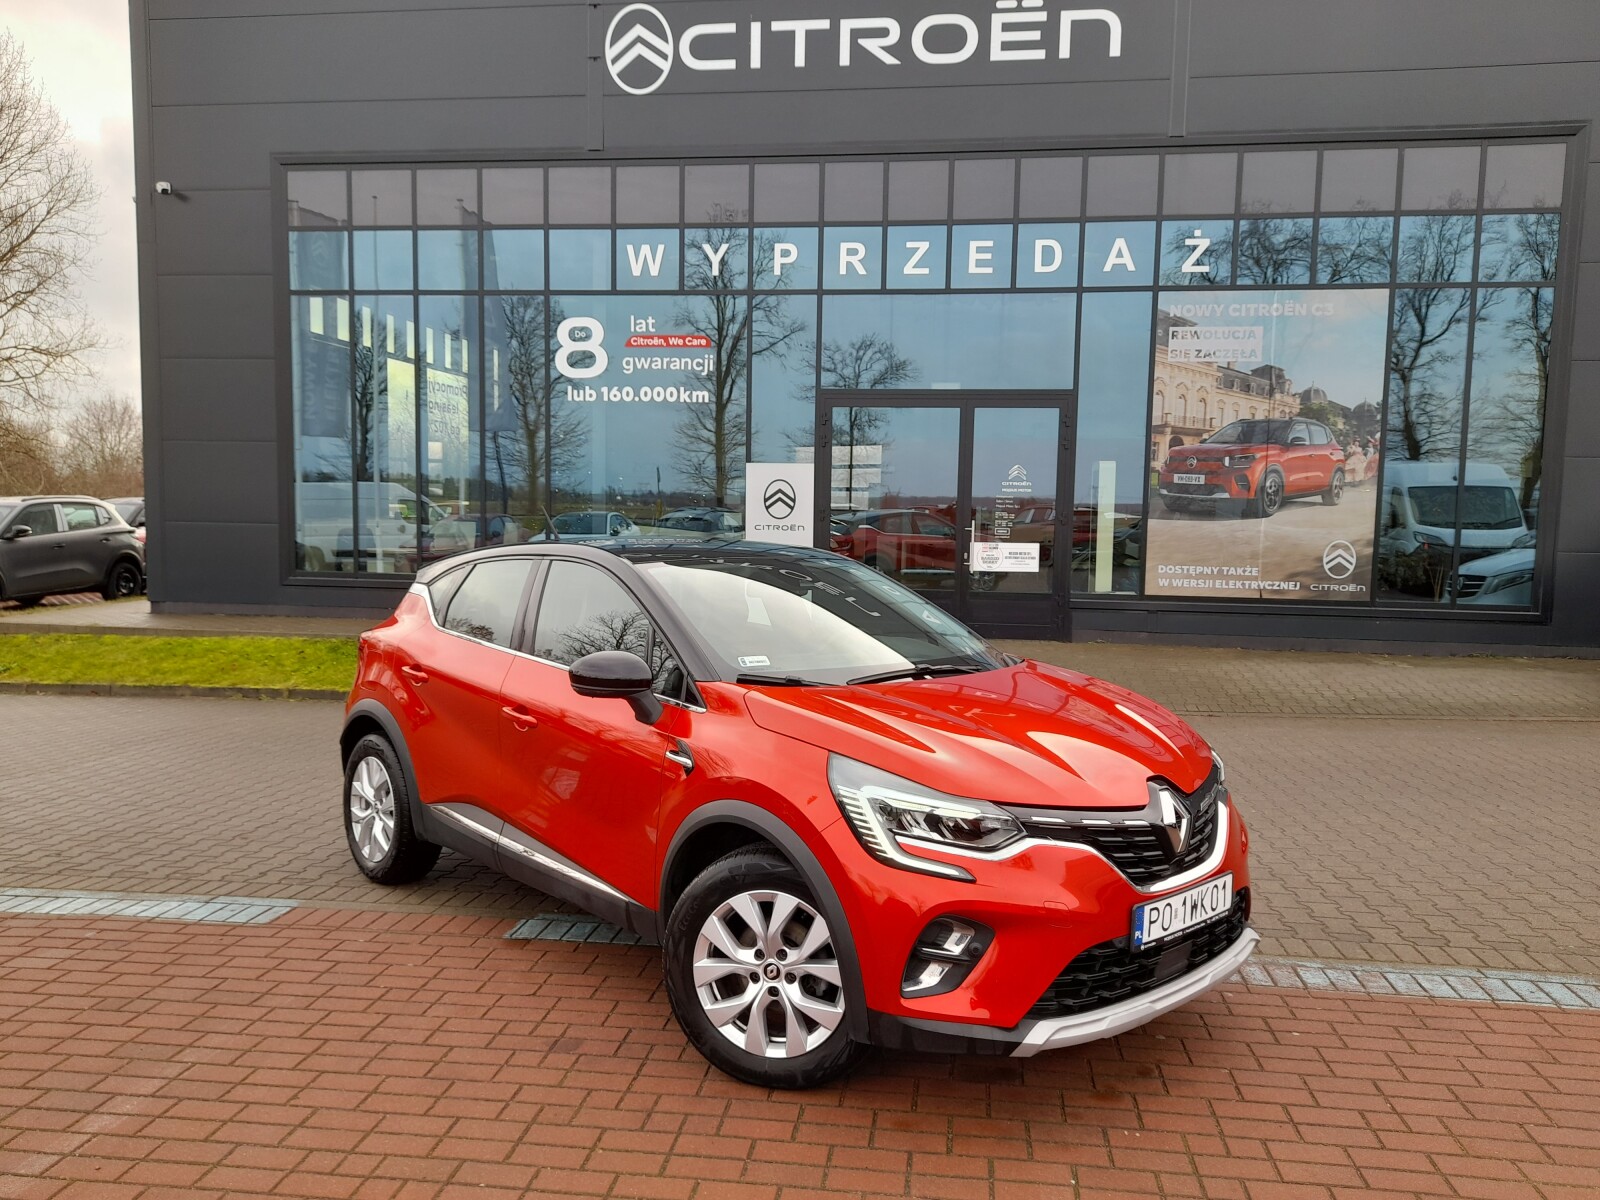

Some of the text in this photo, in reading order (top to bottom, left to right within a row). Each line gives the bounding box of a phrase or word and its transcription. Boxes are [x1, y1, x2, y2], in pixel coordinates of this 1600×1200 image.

[1169, 300, 1335, 318] NOWY CITROËN C3
[630, 315, 656, 333] lat
[574, 330, 586, 339] Do
[1171, 329, 1257, 341] REWOLUCJA
[554, 316, 609, 379] 8
[630, 336, 707, 347] Citroën, We Care
[1169, 349, 1258, 362] SIĘ ZACZĘŁA
[622, 354, 714, 376] gwarancji
[567, 385, 597, 402] lub
[754, 523, 805, 531] CITROËN
[1158, 564, 1259, 577] DOSTĘPNY TAKŻE
[1158, 578, 1300, 591] W WERSJI ELEKTRYCZNEJ
[1310, 583, 1366, 592] CITROËN
[1148, 879, 1227, 938] PO 1WK01
[1134, 930, 1143, 941] PL
